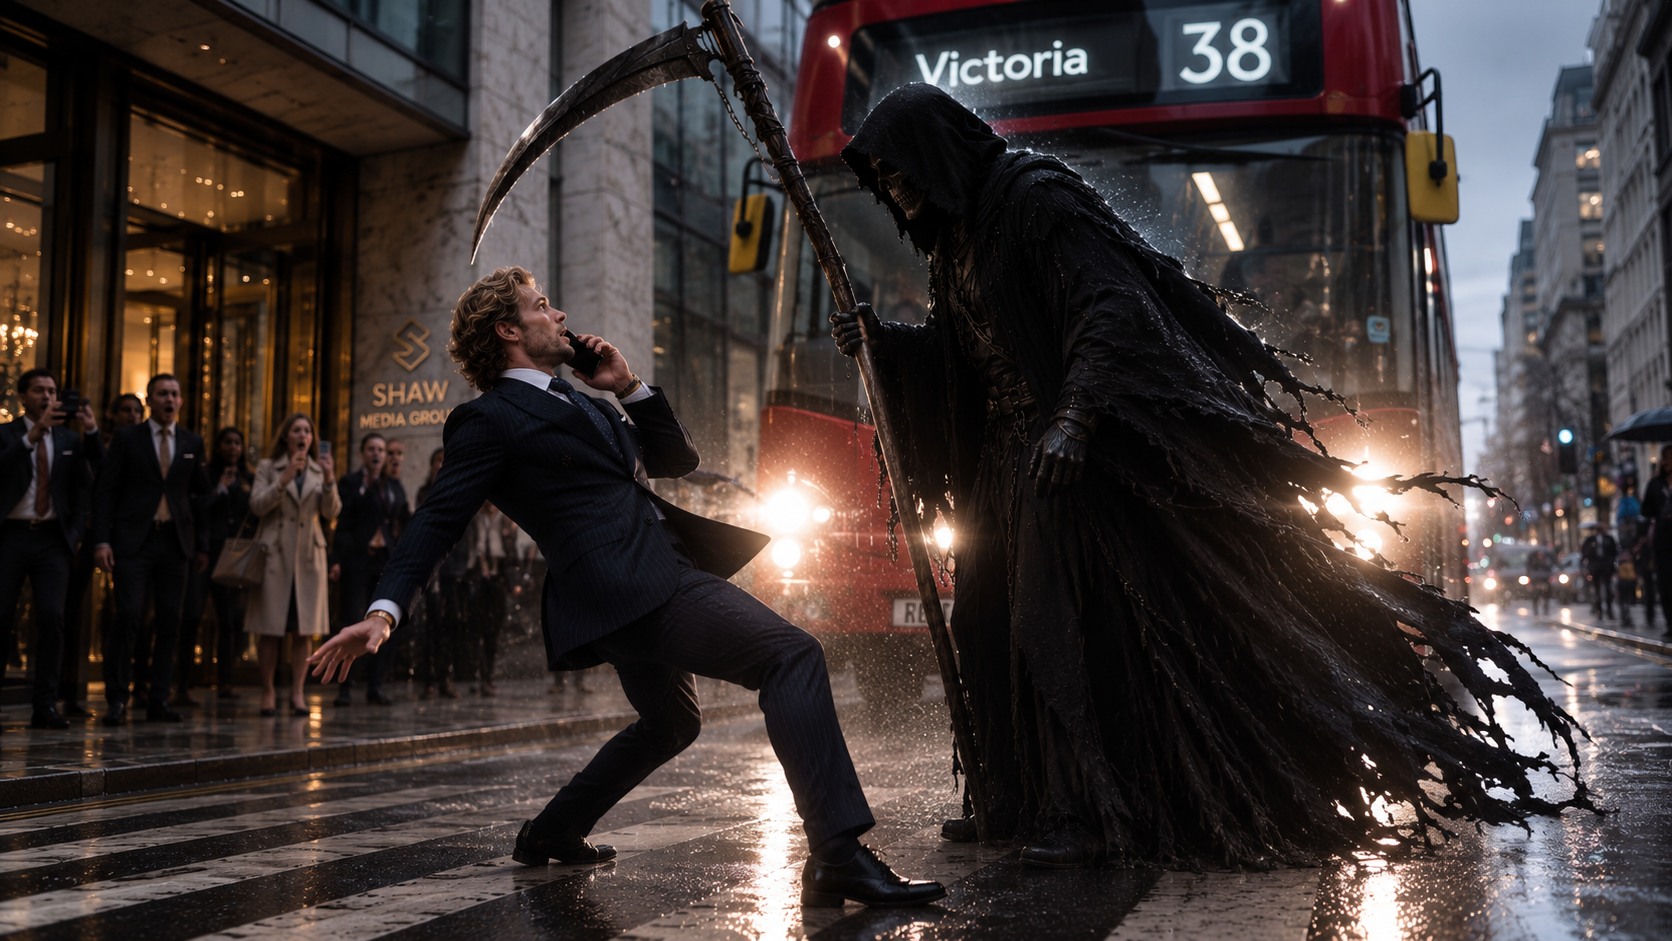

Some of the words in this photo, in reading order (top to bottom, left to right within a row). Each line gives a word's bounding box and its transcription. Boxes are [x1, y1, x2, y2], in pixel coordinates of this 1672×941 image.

[915, 40, 1088, 88] Victoria
[1179, 18, 1272, 84] 38
[372, 380, 449, 407] SHAW
[360, 411, 406, 429] MEDIA
[408, 408, 454, 426] GROU
